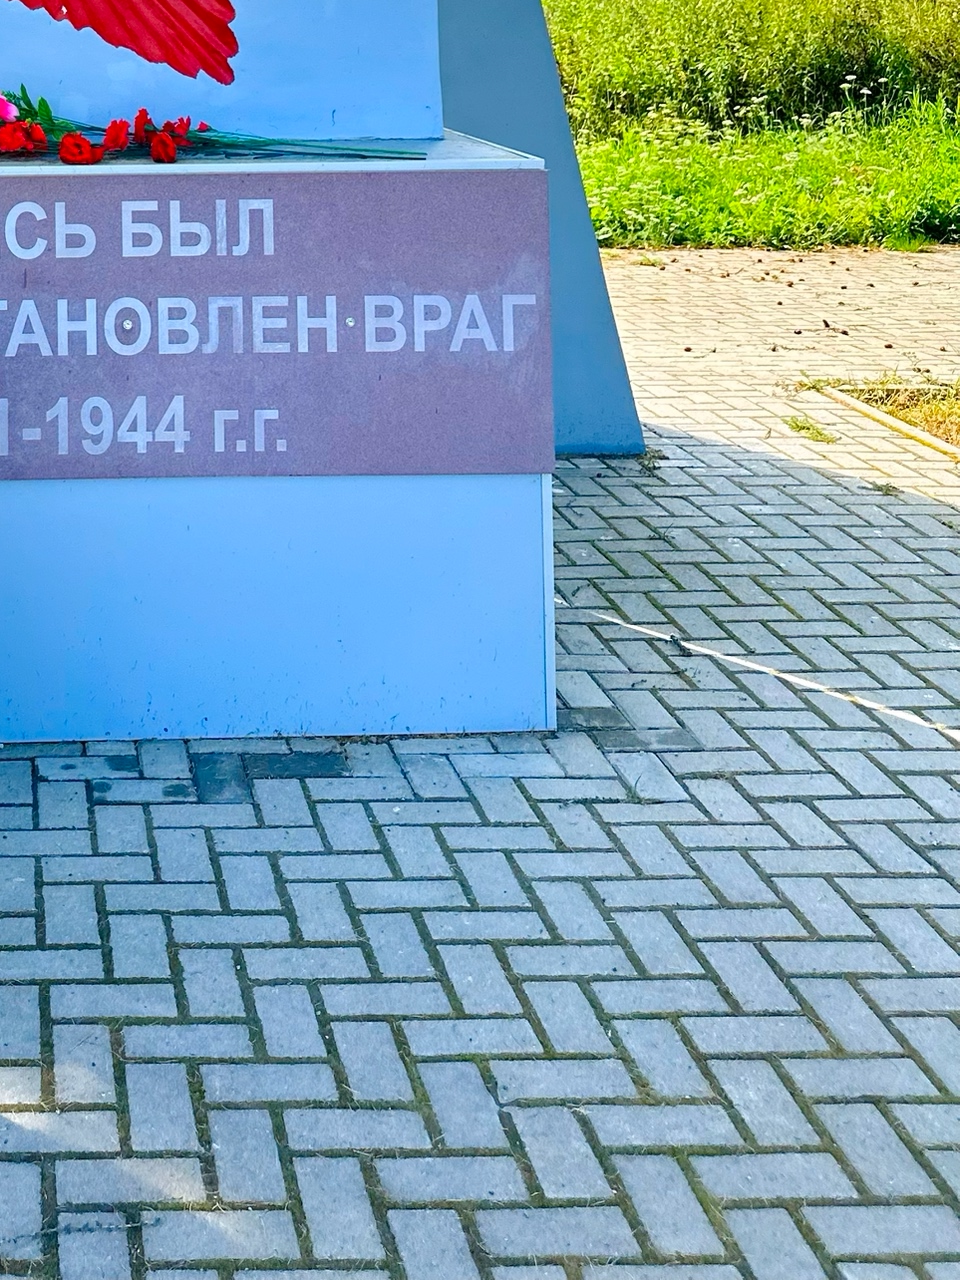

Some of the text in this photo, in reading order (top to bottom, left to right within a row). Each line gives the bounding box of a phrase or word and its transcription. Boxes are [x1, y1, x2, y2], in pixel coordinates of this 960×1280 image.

[121, 198, 275, 258] БЫЛ
[364, 294, 537, 353] ВРАГ
[213, 409, 287, 453] г.г.
